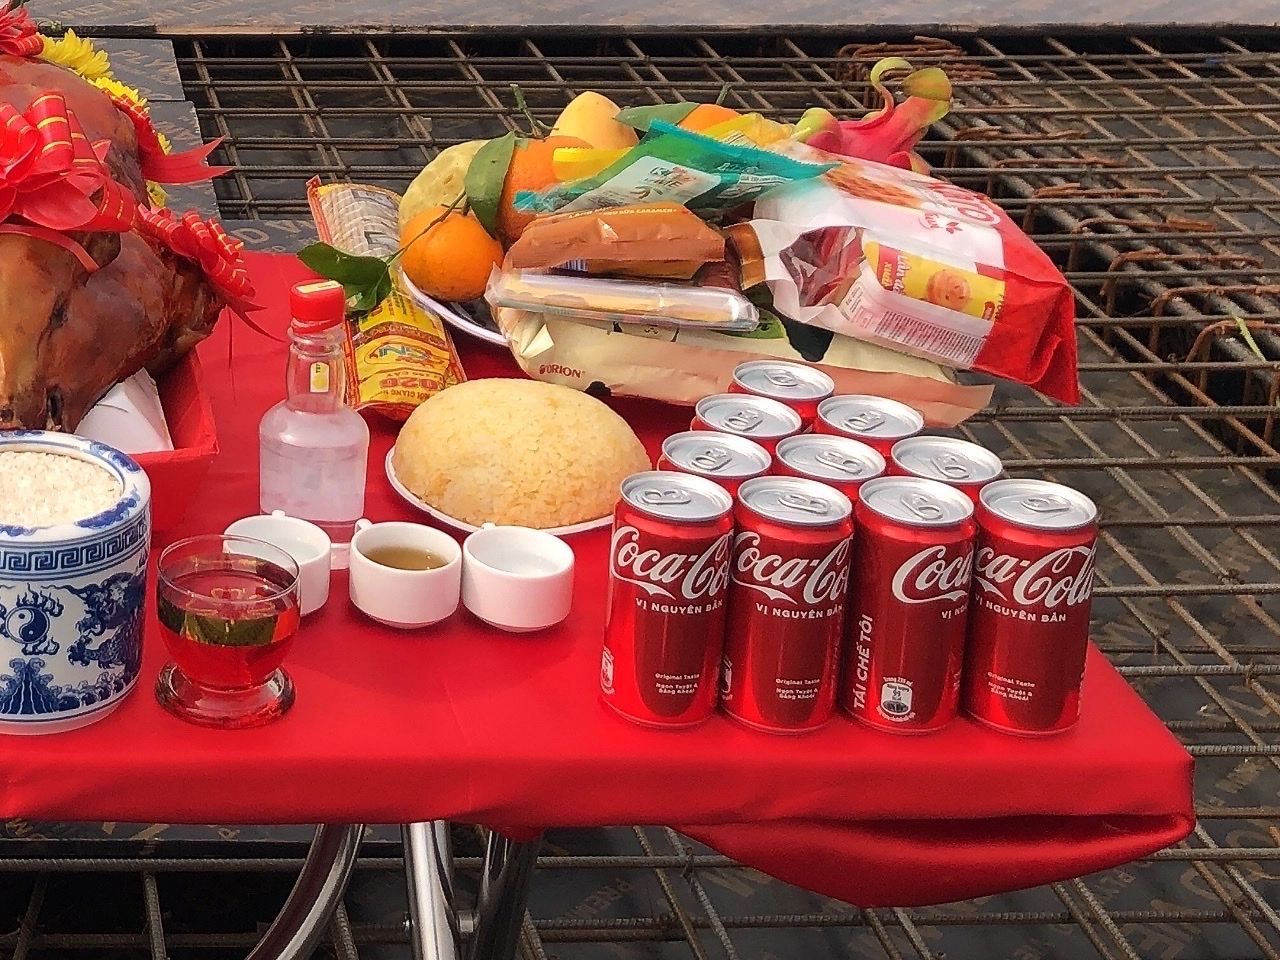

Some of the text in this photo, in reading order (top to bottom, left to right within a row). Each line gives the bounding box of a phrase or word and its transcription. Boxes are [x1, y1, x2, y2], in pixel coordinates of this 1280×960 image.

[651, 602, 702, 615] NGUYÊN
[756, 602, 768, 615] VỊ
[772, 608, 824, 619] NGUYÊN
[985, 600, 1037, 622] NGUYÊN
[1041, 611, 1067, 623] BẢN
[853, 614, 873, 709] TÁI CHẾ TÔI
